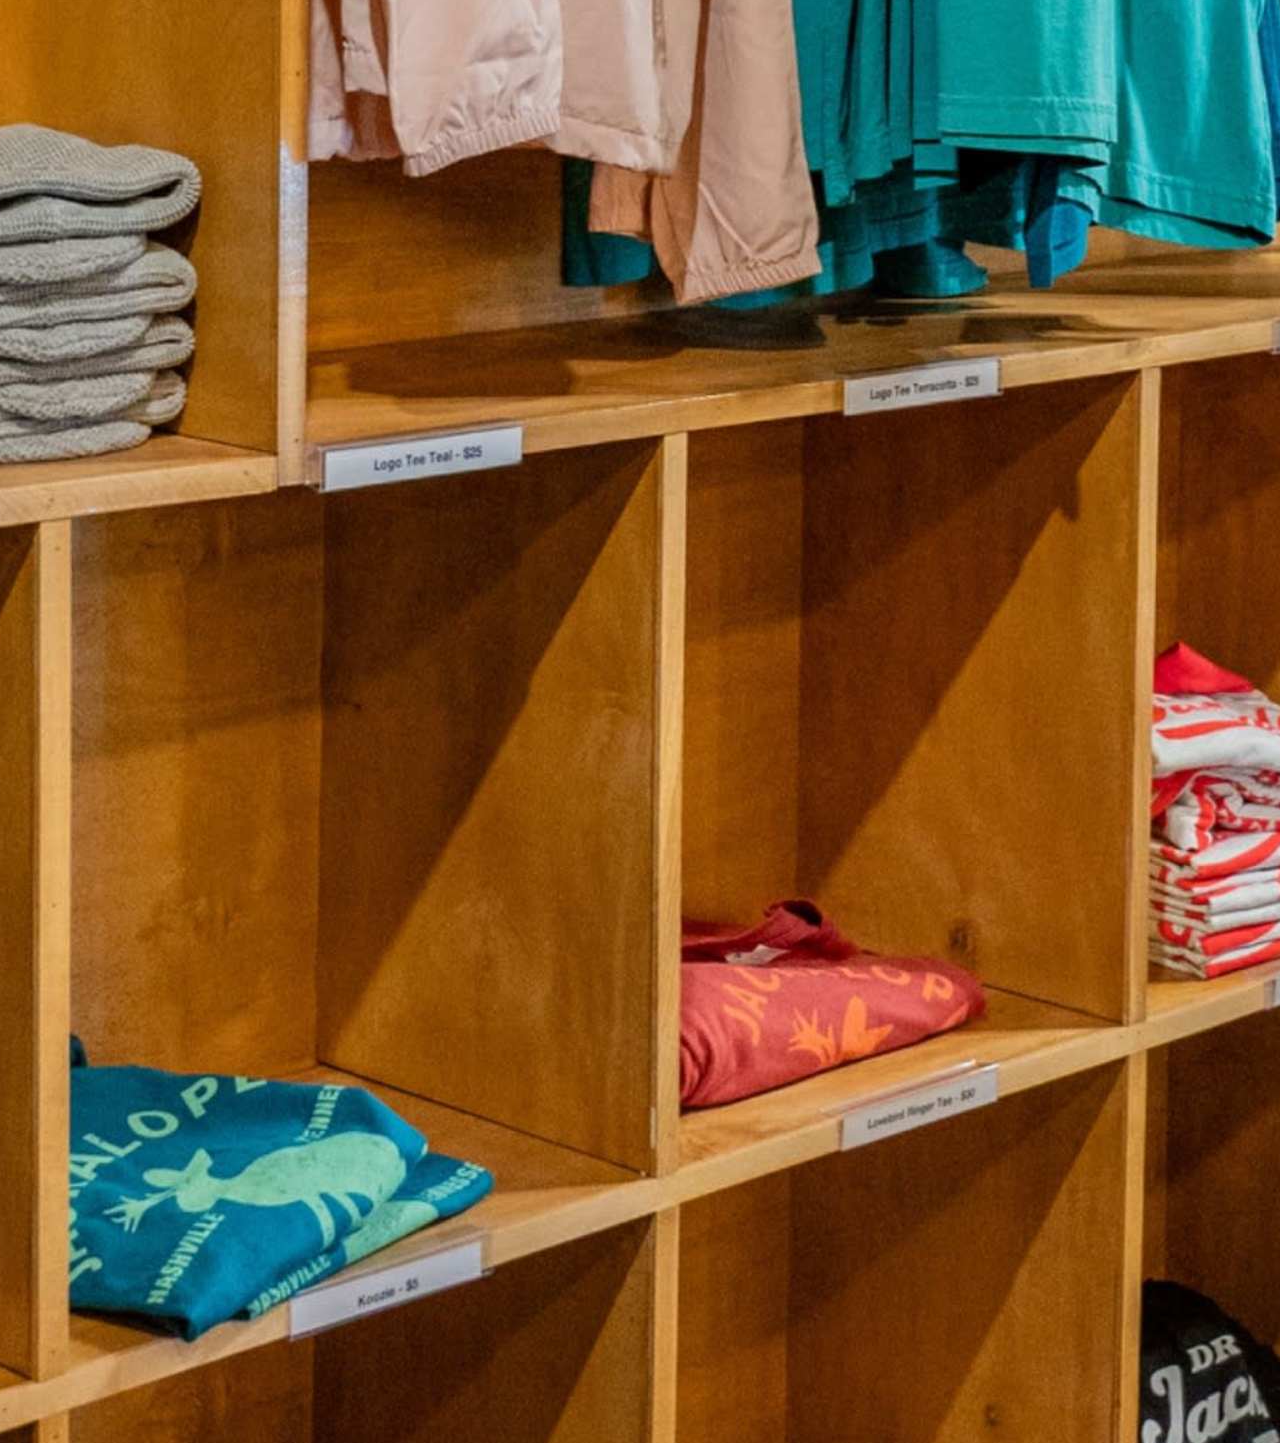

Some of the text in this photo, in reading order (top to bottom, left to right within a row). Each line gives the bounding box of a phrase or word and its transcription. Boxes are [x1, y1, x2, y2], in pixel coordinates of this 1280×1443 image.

[869, 387, 893, 401] Logo
[373, 445, 483, 474] Logo Tee Teal $25
[147, 1210, 226, 1306] NASHVILLE
[357, 1284, 396, 1309] Koozie
